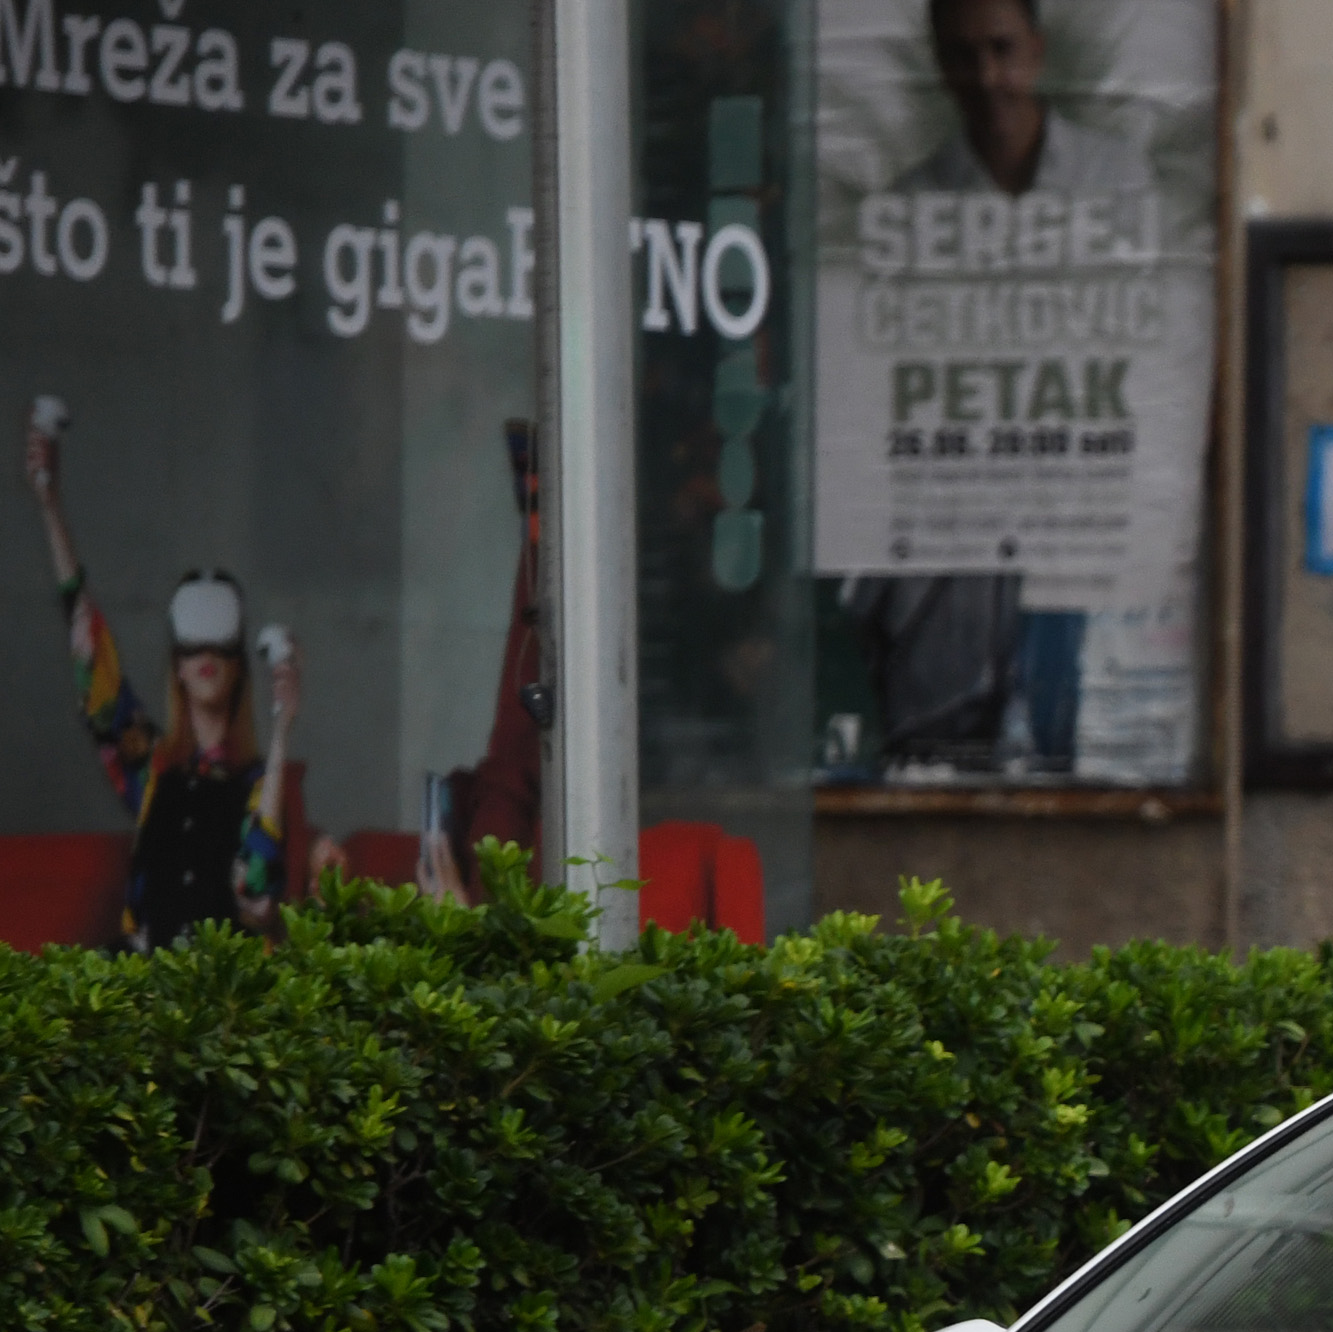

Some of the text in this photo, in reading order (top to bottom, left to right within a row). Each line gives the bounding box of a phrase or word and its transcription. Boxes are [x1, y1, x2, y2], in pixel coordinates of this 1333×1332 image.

[0, 0, 526, 140] Mreža za sve
[136, 180, 198, 291] ti
[222, 184, 298, 325] je
[859, 191, 1160, 271] SERGEJ
[891, 358, 1133, 422] PETAK
